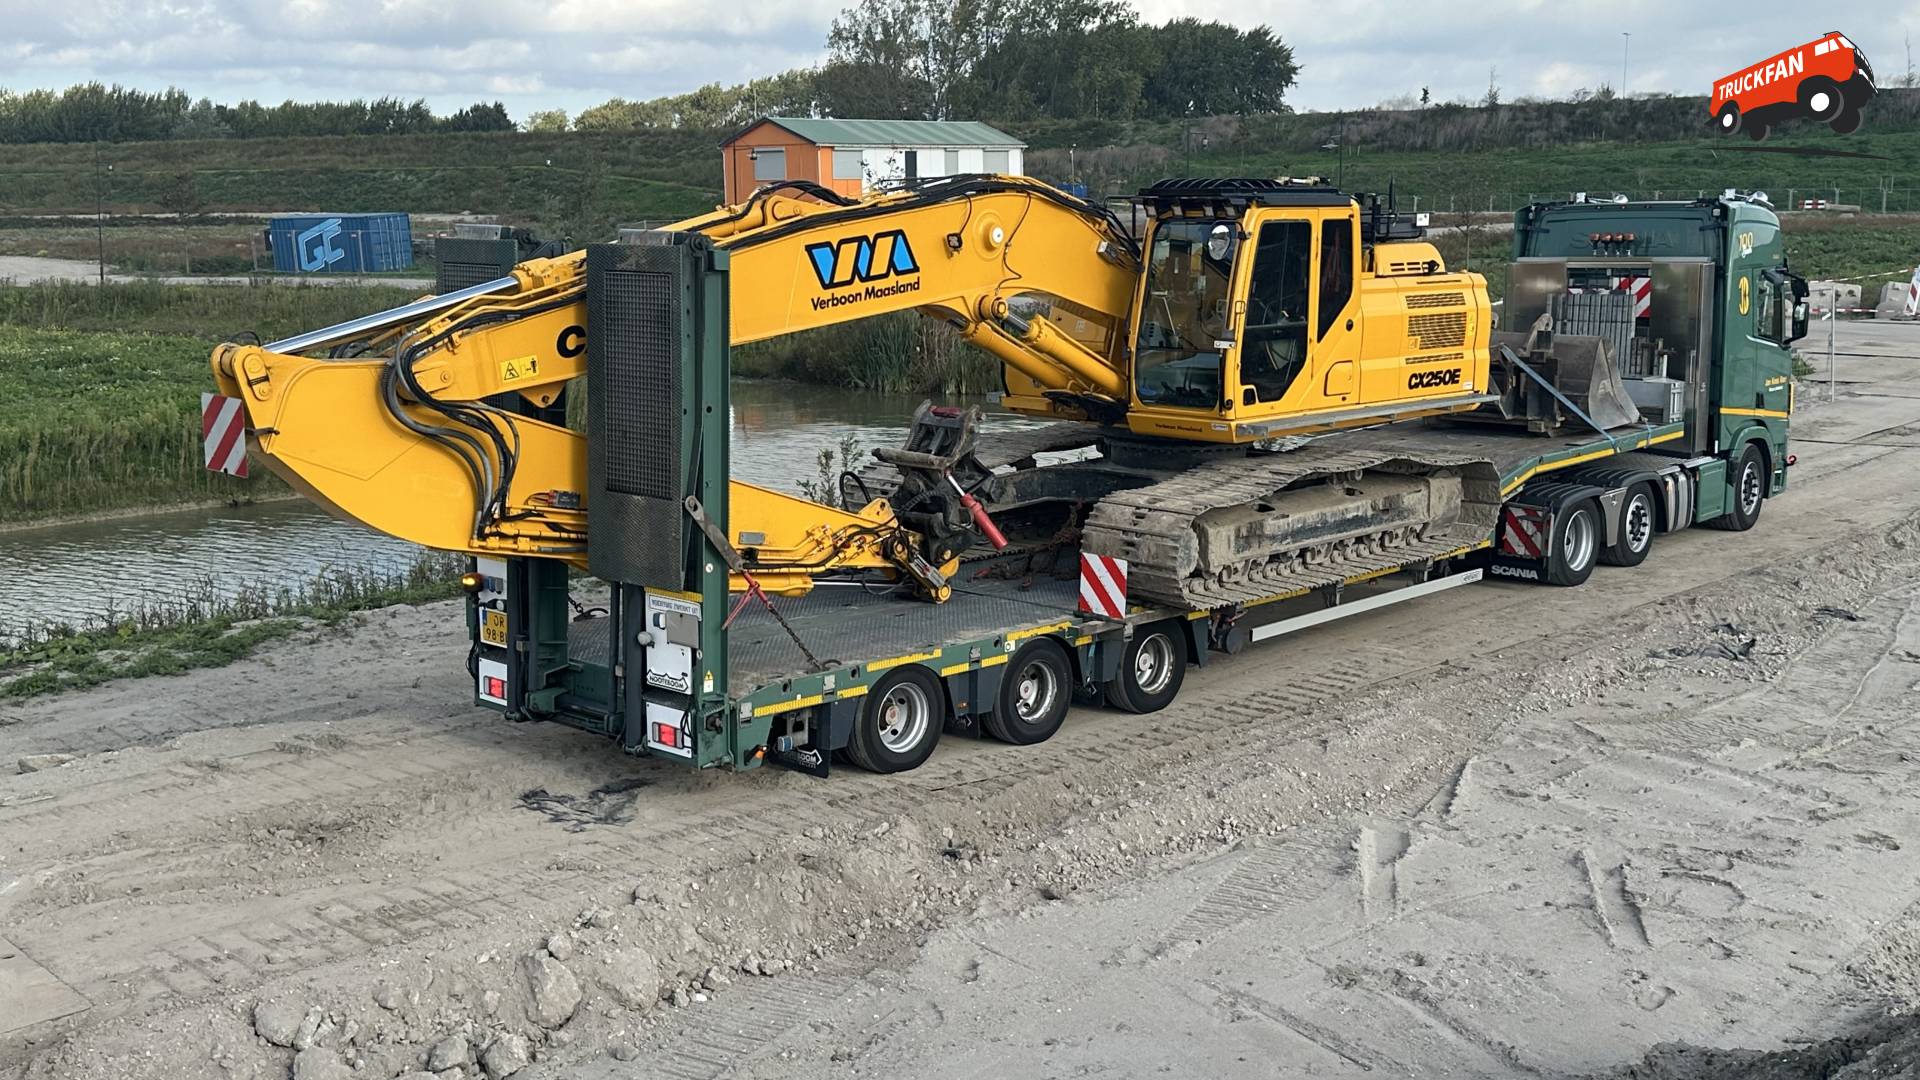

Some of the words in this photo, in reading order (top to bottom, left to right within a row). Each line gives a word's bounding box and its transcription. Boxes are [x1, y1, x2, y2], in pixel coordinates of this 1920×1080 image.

[811, 293, 862, 311] Verboon
[864, 276, 920, 301] Maasland
[1408, 368, 1462, 390] CX250E
[1491, 564, 1538, 580] SCANIA
